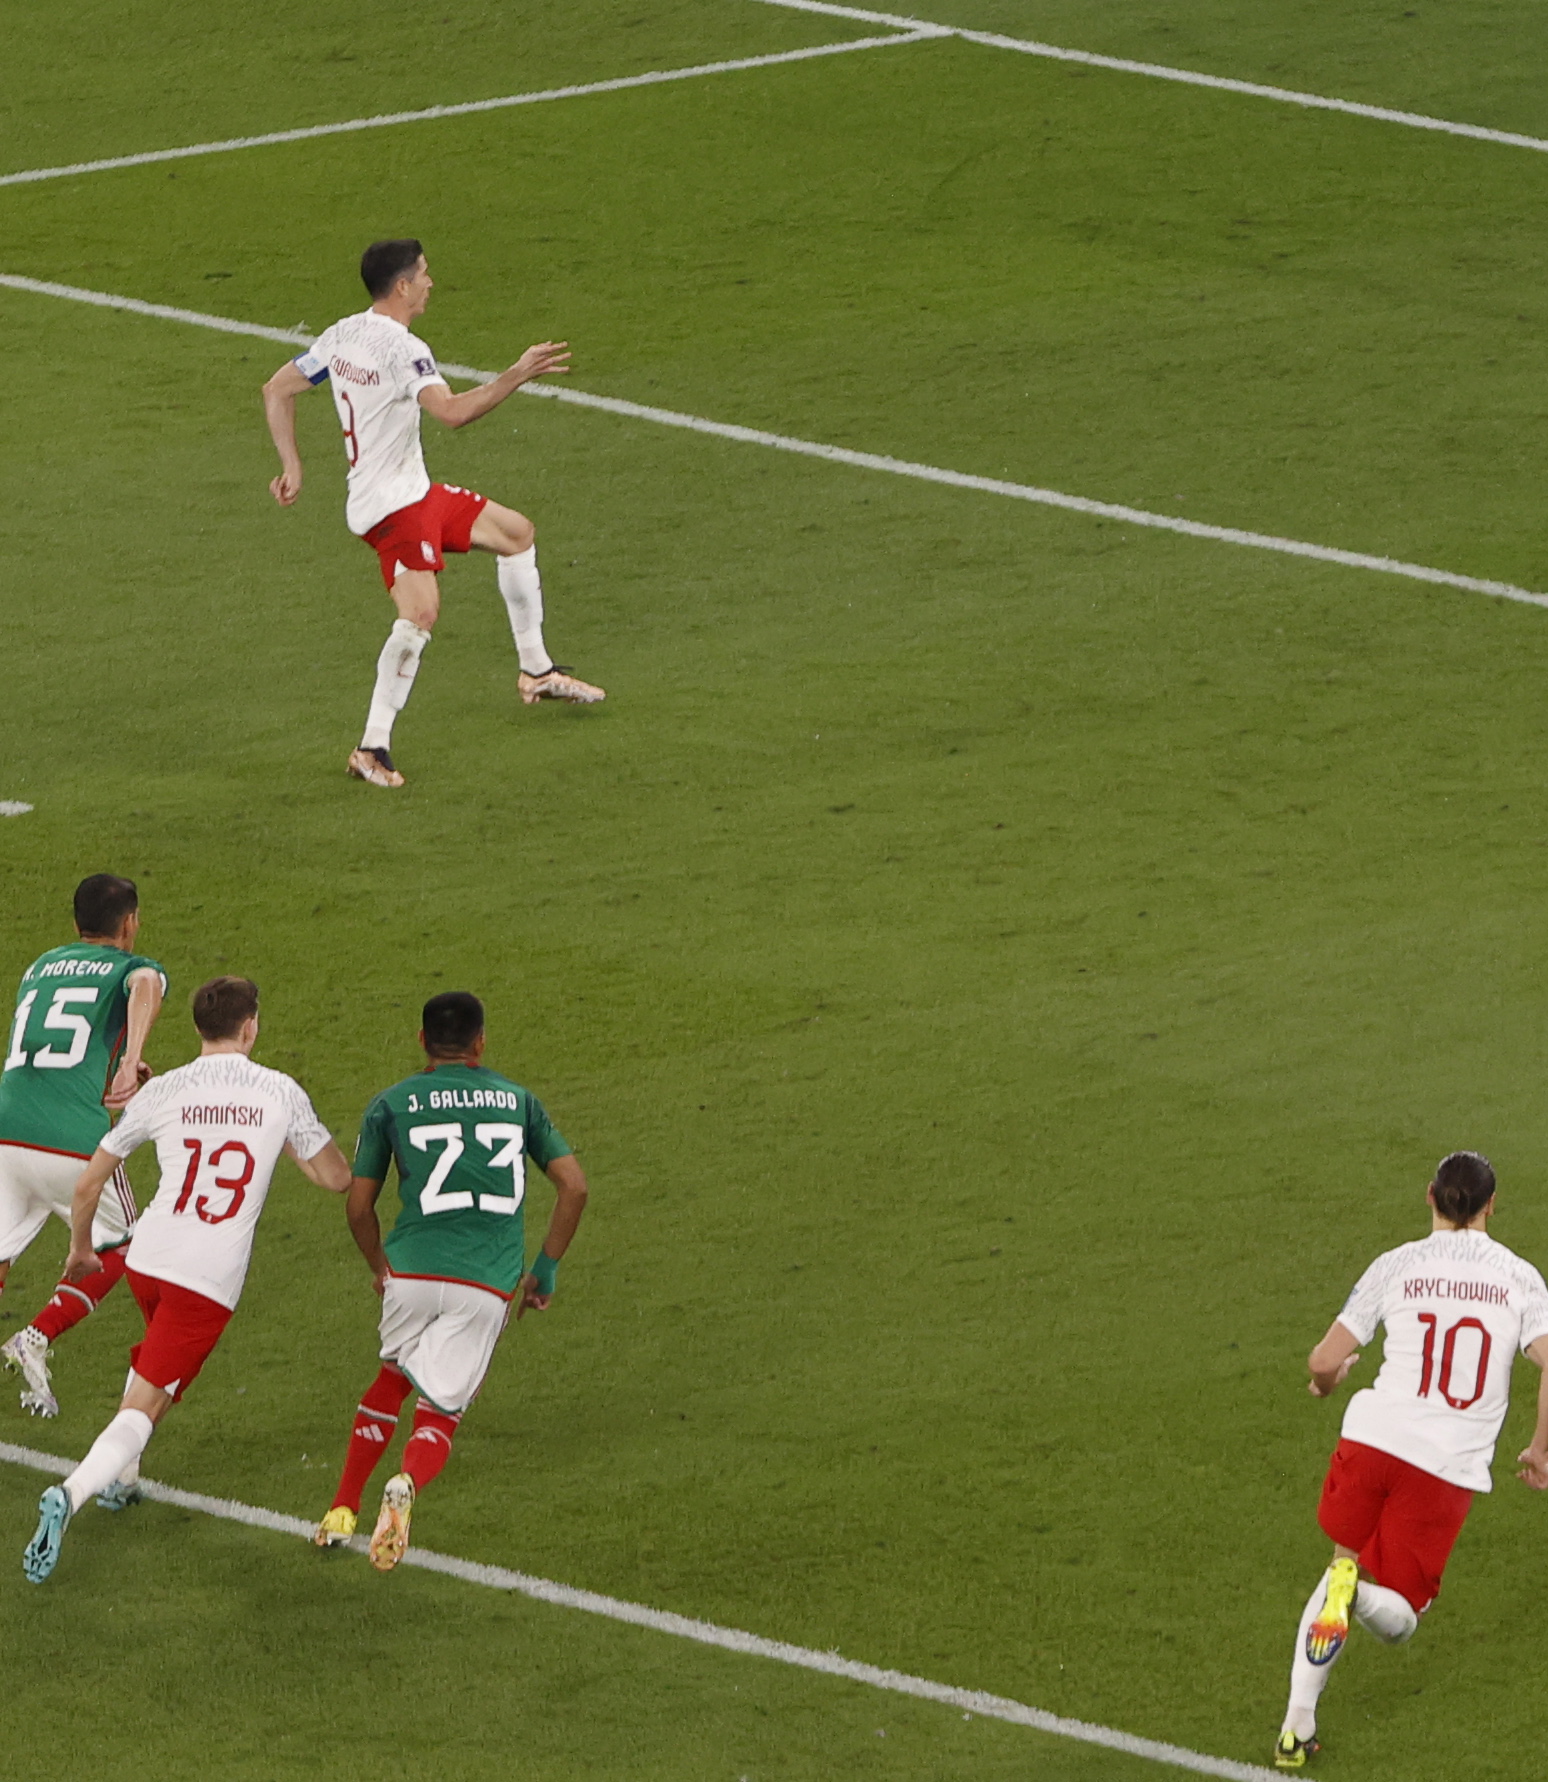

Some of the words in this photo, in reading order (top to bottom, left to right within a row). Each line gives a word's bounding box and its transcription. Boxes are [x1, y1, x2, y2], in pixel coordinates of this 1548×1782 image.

[40, 959, 114, 978] MORENO
[4, 983, 99, 1072] 15
[182, 1101, 263, 1128] KAMIŃSKI
[408, 1094, 424, 1113] J.
[430, 1089, 518, 1111] GALLARDO
[173, 1138, 255, 1225] 13
[409, 1122, 525, 1216] 23
[1404, 1278, 1509, 1307] KRYCHOWIAK
[1417, 1312, 1492, 1410] 10
